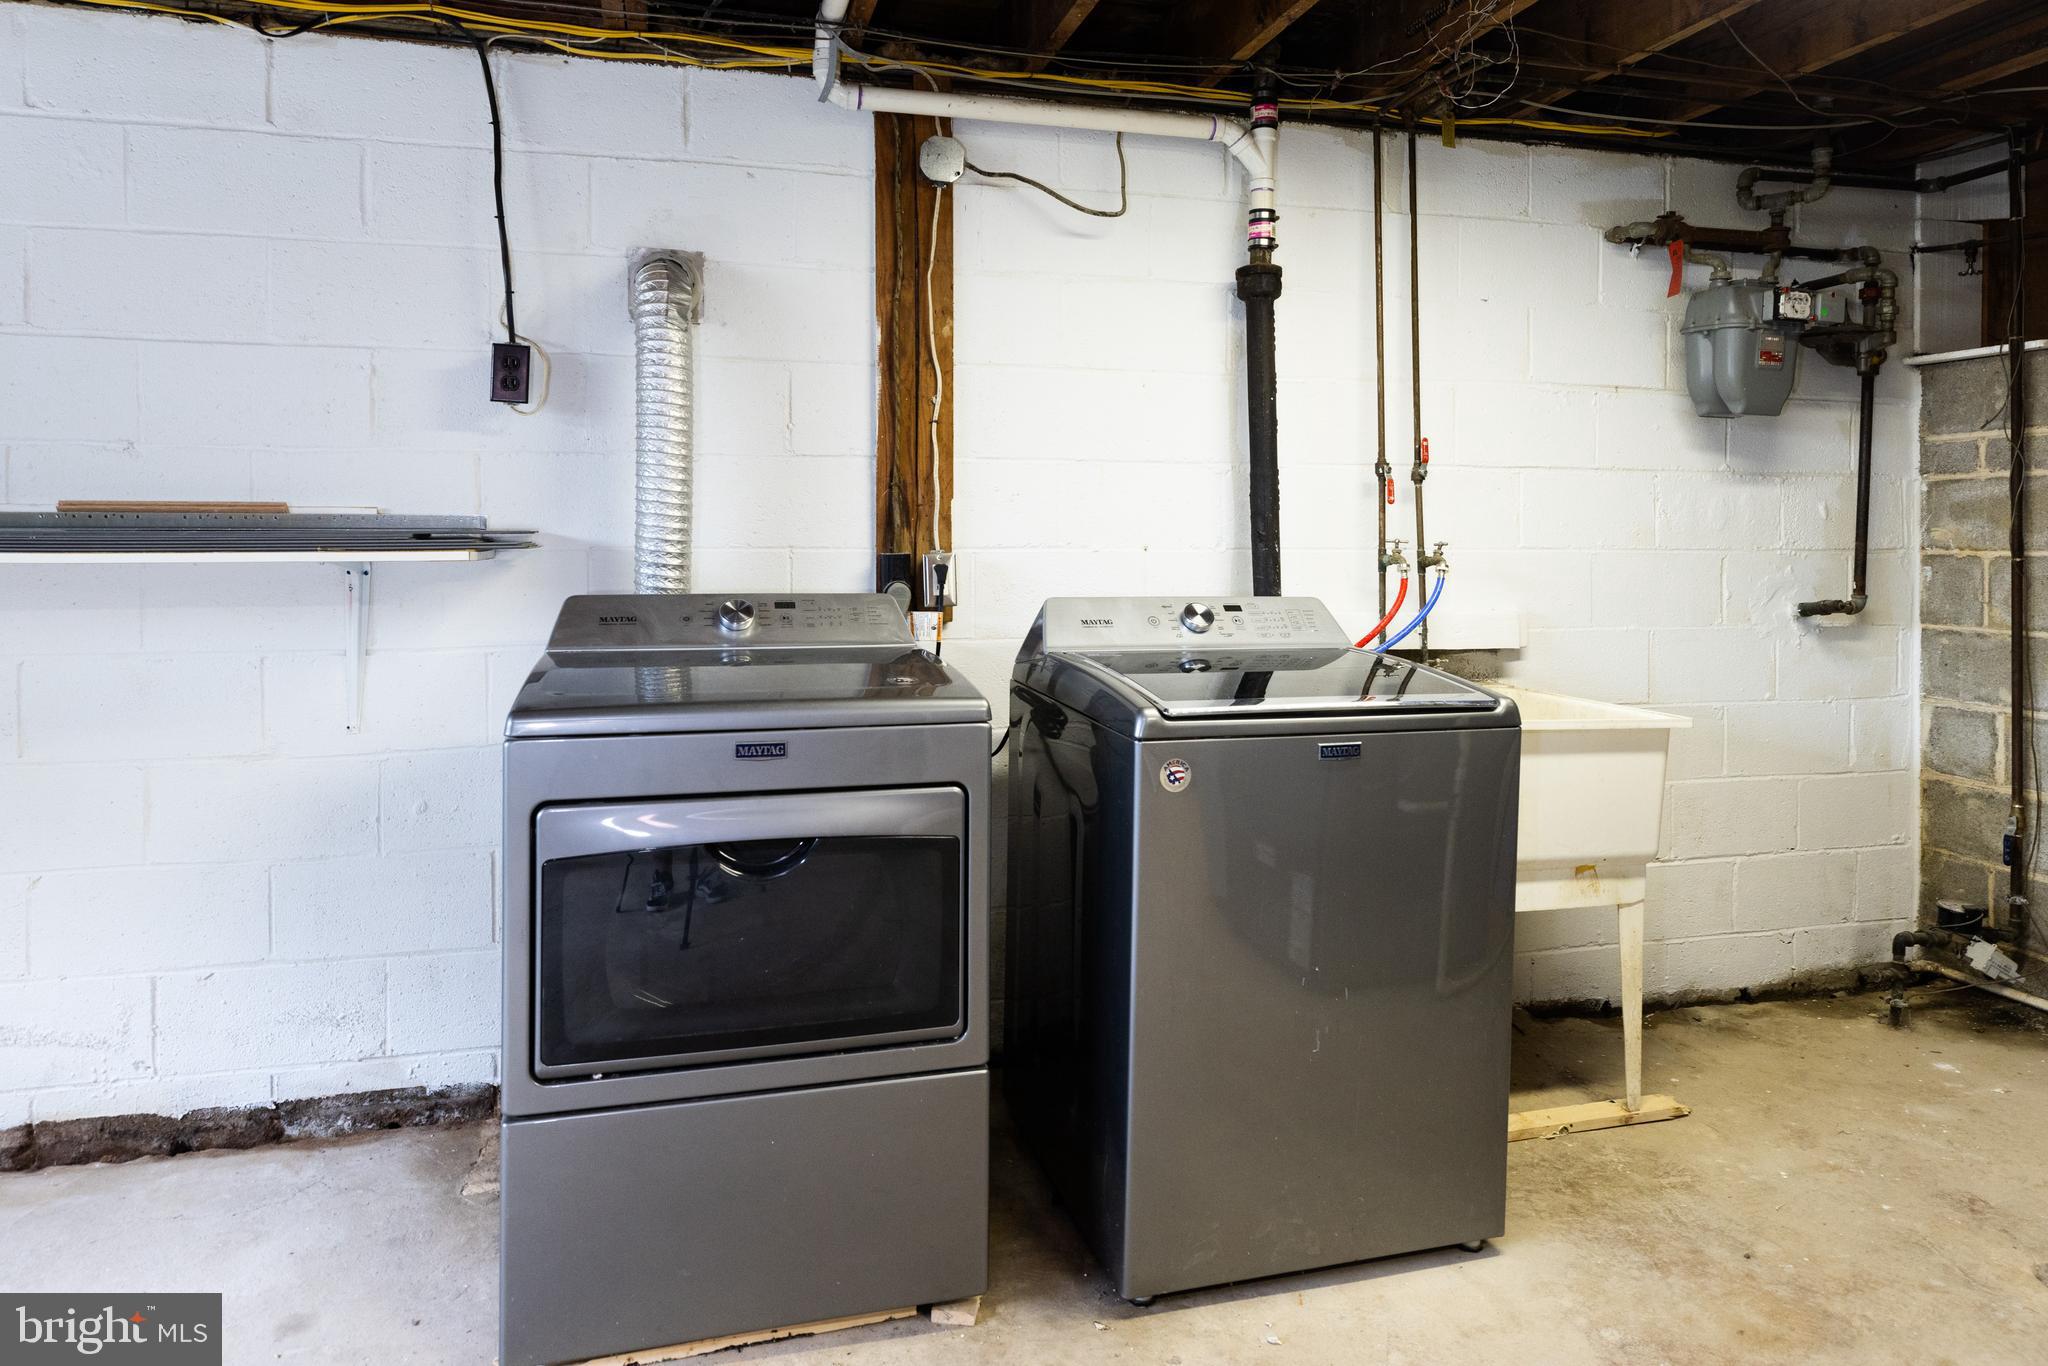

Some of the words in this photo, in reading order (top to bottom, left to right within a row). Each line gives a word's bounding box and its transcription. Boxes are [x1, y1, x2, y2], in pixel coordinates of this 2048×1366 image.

[737, 745, 784, 756] MAYTAG
[1321, 746, 1360, 757] MAYTAG
[1164, 760, 1189, 772] AMERICA
